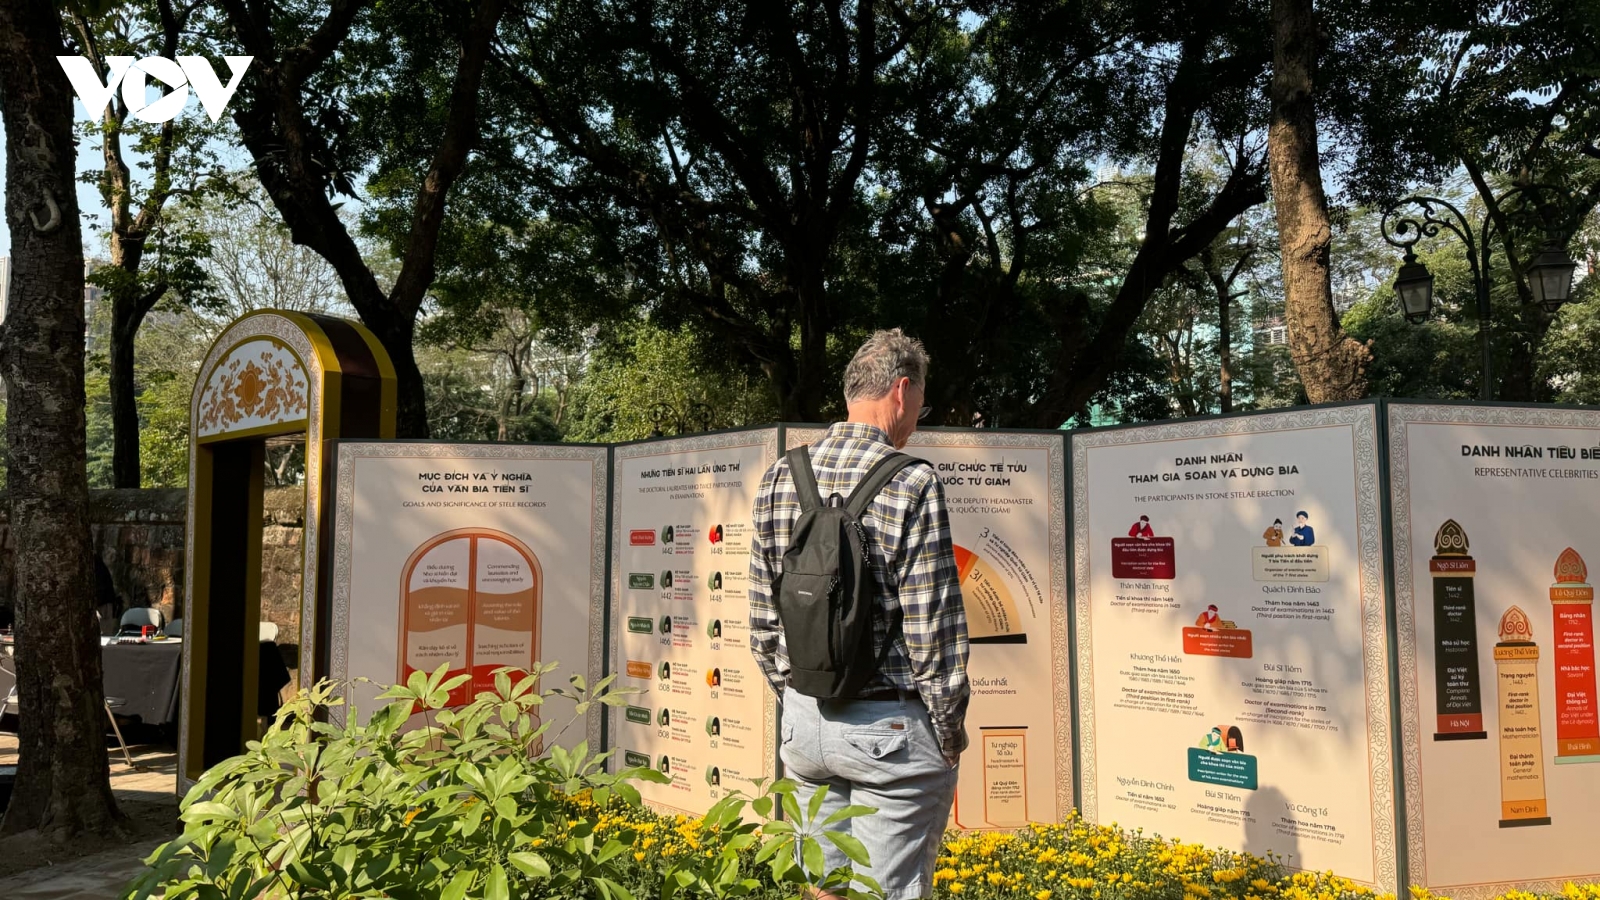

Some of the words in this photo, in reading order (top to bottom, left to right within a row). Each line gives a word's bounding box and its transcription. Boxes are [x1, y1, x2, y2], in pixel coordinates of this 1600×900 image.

[1462, 445, 1499, 457] DANH
[1505, 445, 1542, 458] NHÂN
[1581, 444, 1600, 459] BIỂ
[1176, 457, 1206, 466] DANH
[1211, 452, 1243, 463] NHÂN
[419, 473, 440, 481] MỤC
[942, 471, 963, 485] UỐC
[1129, 474, 1158, 483] THAM
[1162, 473, 1180, 481] GIA
[1279, 465, 1299, 475] BIA
[1475, 467, 1546, 478] REPRESENTATIVE
[1549, 469, 1598, 478] CELEBRITIES
[1148, 494, 1194, 502] PARTICIPANTS
[1205, 492, 1229, 500] STONE
[1231, 491, 1256, 499] STELAE
[1257, 490, 1294, 498] ERECTION
[1262, 585, 1285, 594] Quách
[1144, 689, 1177, 697] examinations
[1270, 701, 1307, 710] examinations
